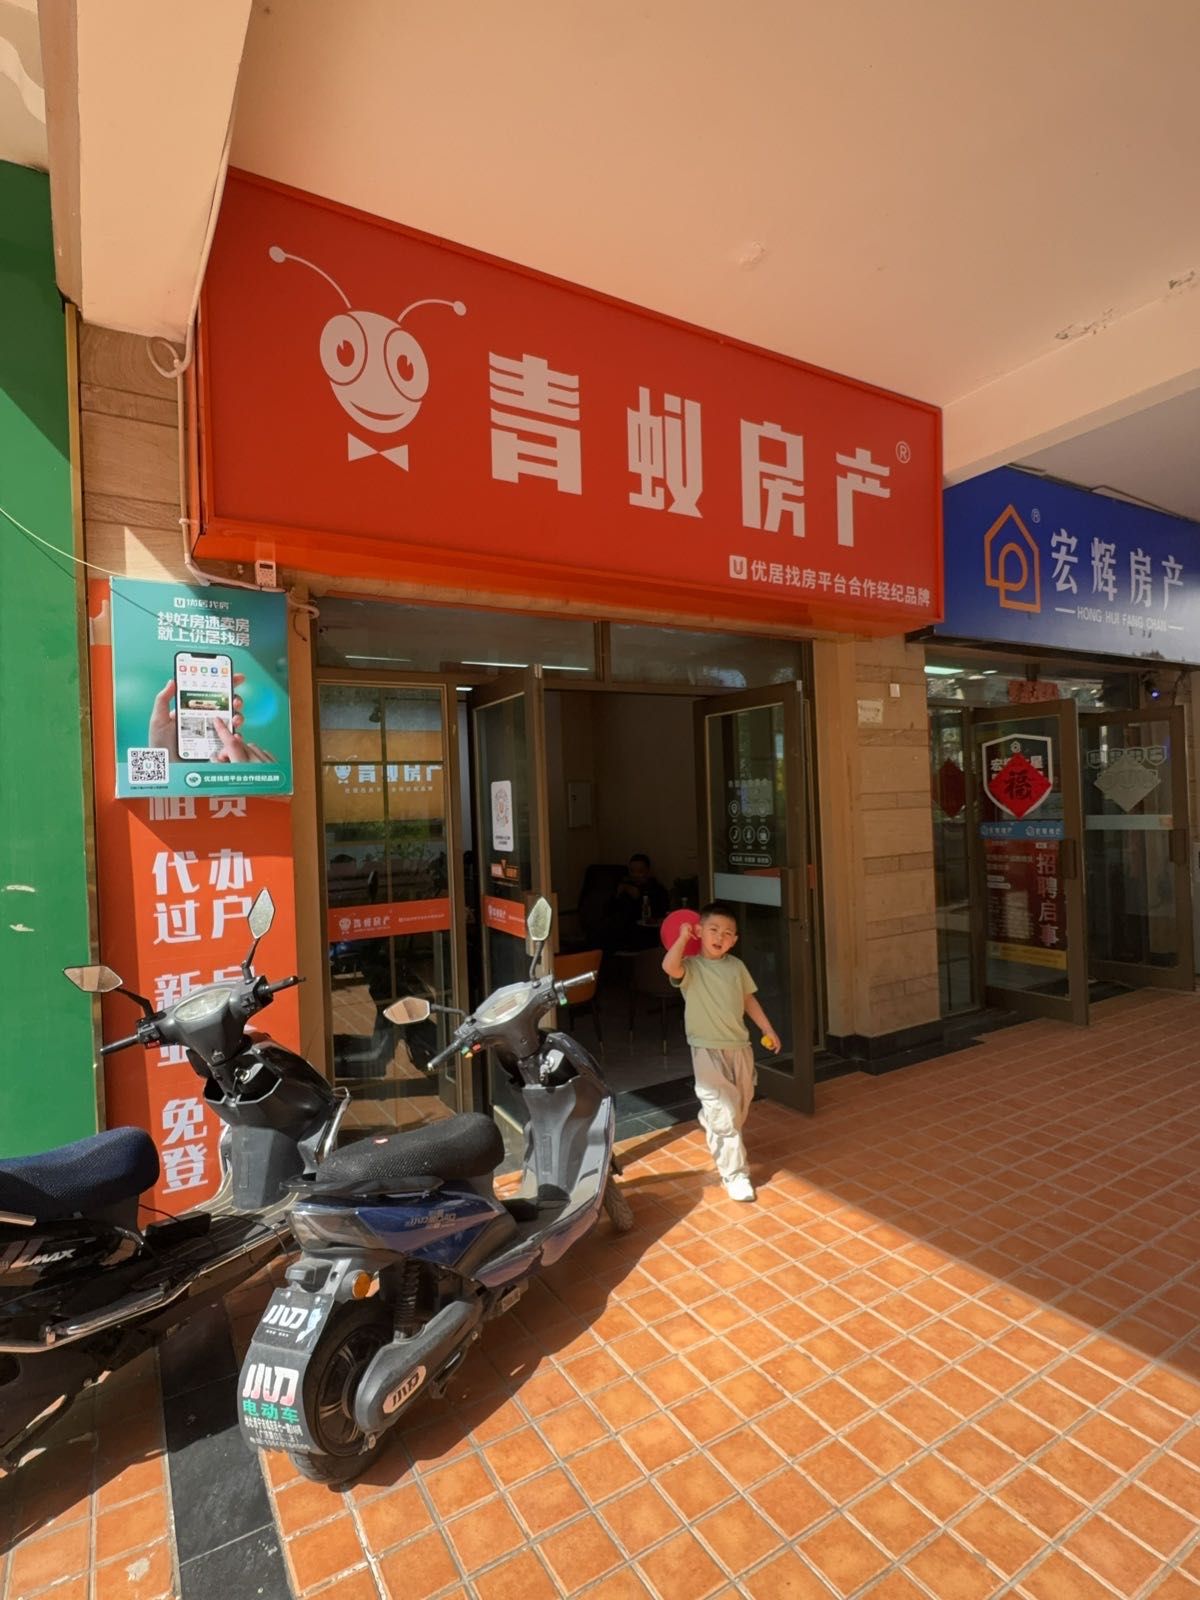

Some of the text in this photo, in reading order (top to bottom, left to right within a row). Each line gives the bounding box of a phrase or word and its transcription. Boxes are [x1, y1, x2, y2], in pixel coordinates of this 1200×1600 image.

[489, 352, 890, 547] 青蚁房产
[751, 560, 931, 607] 优居找房平台合作经纪品牌
[1050, 528, 1184, 611] 宏辉房产
[157, 611, 250, 633] 找好房速卖房
[157, 626, 250, 647] 就上优居找房
[1076, 606, 1168, 632] HONG HUI FANG CHAN
[152, 848, 254, 896] 代办
[153, 895, 254, 944] 过户
[1035, 852, 1059, 946] 招聘启事
[242, 1399, 299, 1424] 电动车
